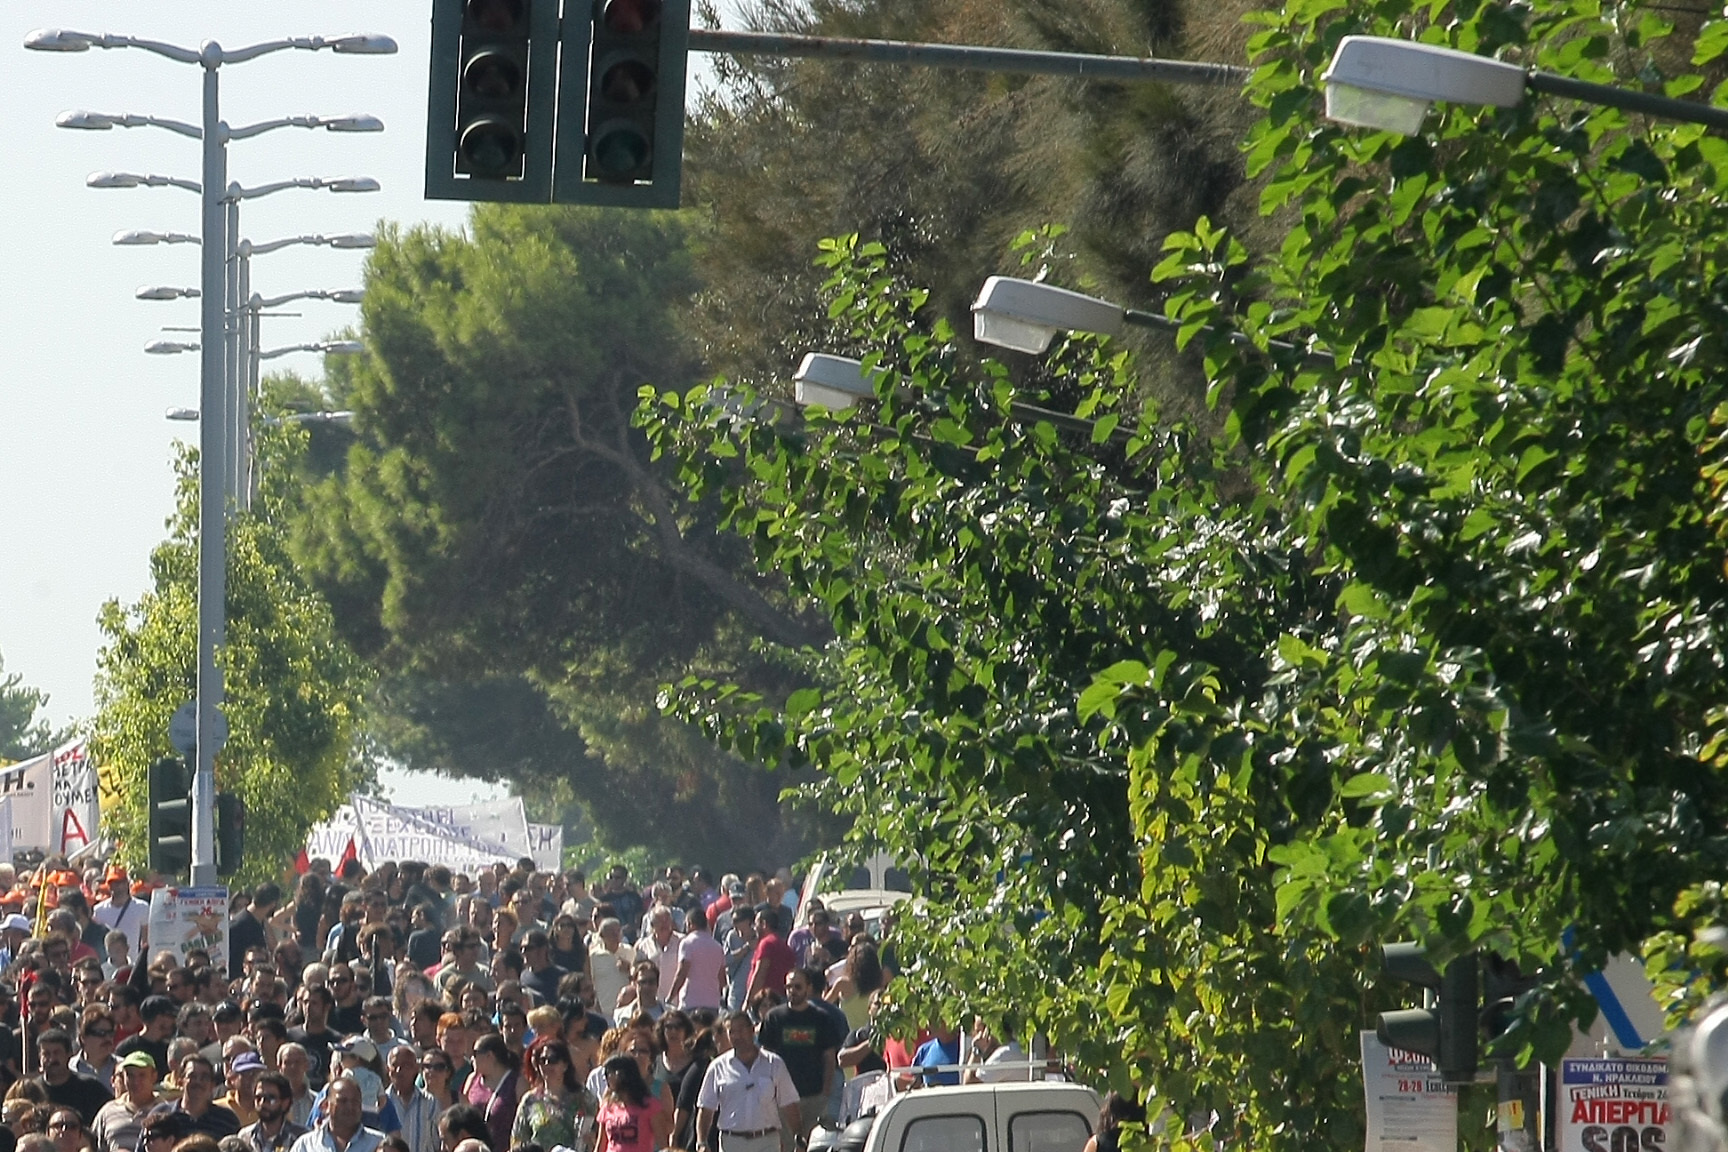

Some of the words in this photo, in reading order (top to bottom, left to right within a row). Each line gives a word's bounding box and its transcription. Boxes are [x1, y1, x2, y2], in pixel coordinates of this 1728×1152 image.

[1570, 1062, 1623, 1073] ΣΥΝΔΙΚΑΤΟ
[1606, 1074, 1657, 1085] ΗΡΑΚΛΕΙΟΥ
[1572, 1085, 1619, 1101] ΓΕΝΙΚΗ
[1571, 1100, 1672, 1125] ΑΠΕΡΓΙΑ
